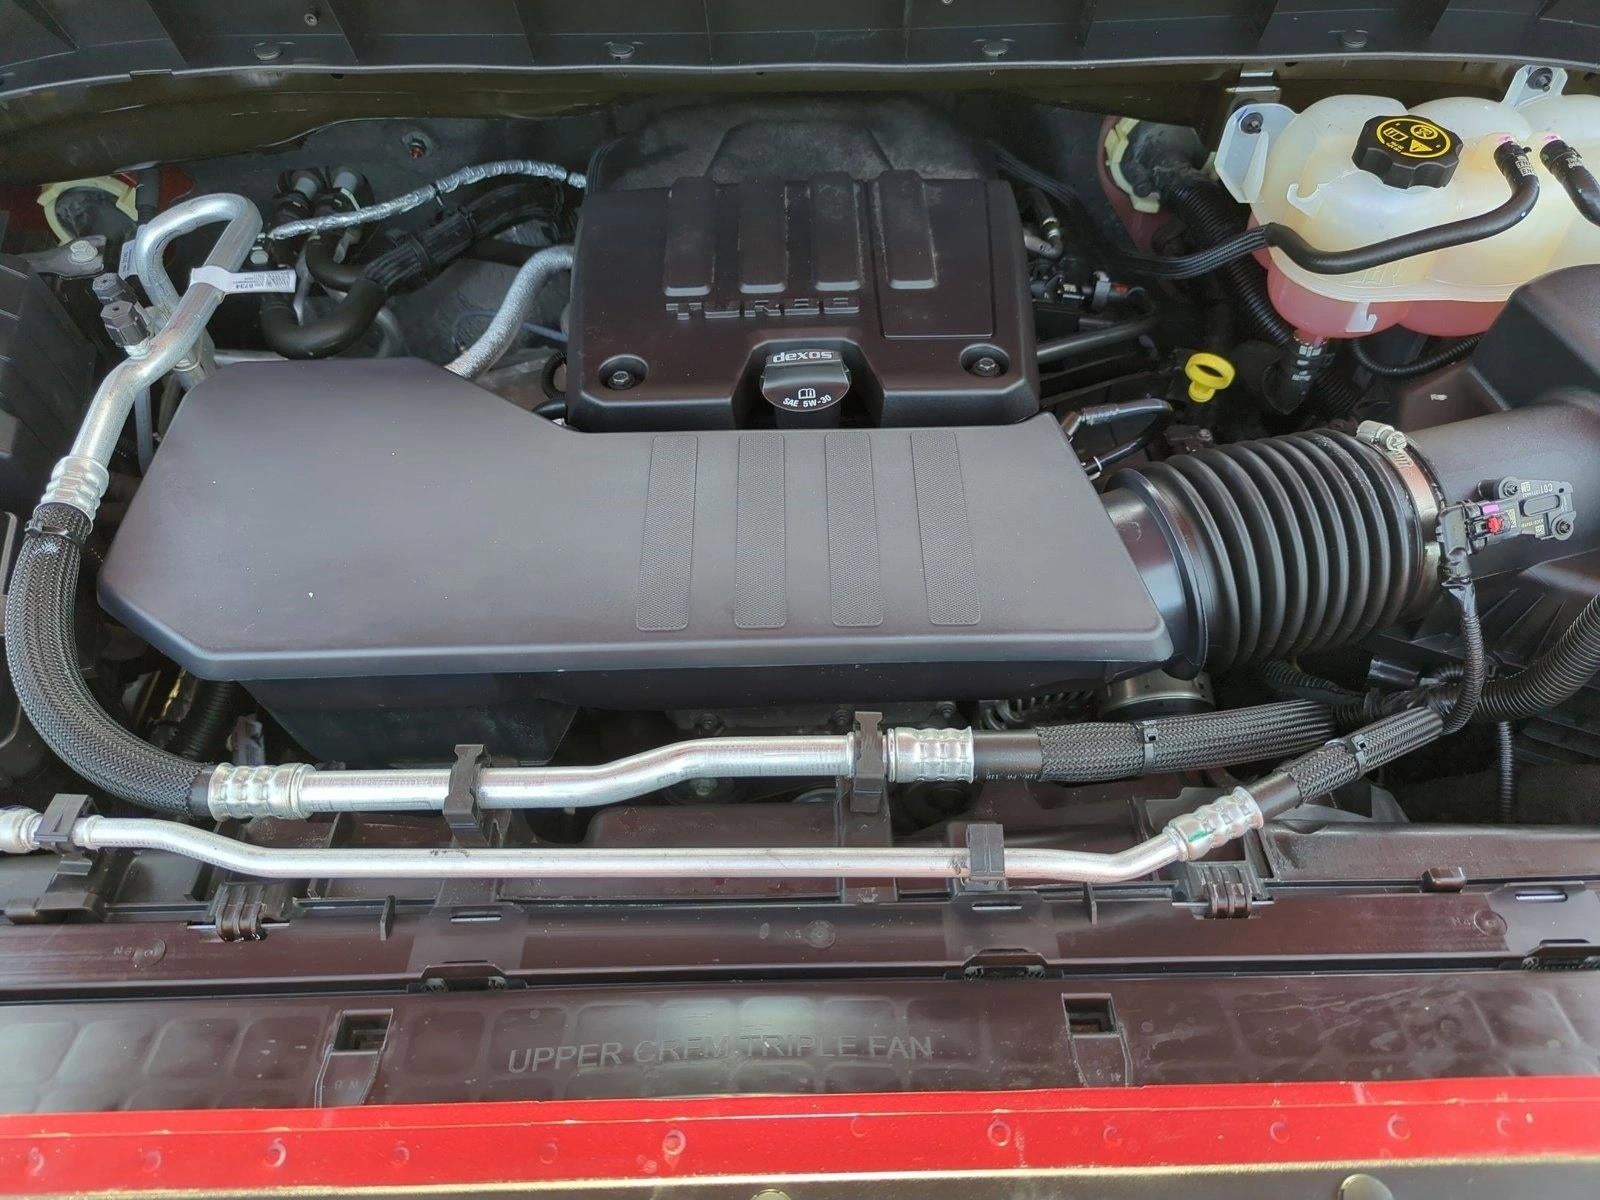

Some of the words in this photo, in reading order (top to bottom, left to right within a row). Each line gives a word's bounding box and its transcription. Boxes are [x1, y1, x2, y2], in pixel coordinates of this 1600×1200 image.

[772, 351, 833, 363] dexos
[783, 397, 799, 407] SAE
[802, 395, 832, 407] 5W-30
[508, 1042, 623, 1073] UPPER
[740, 1034, 858, 1058] TRIPLE
[868, 1036, 932, 1059] FAN
